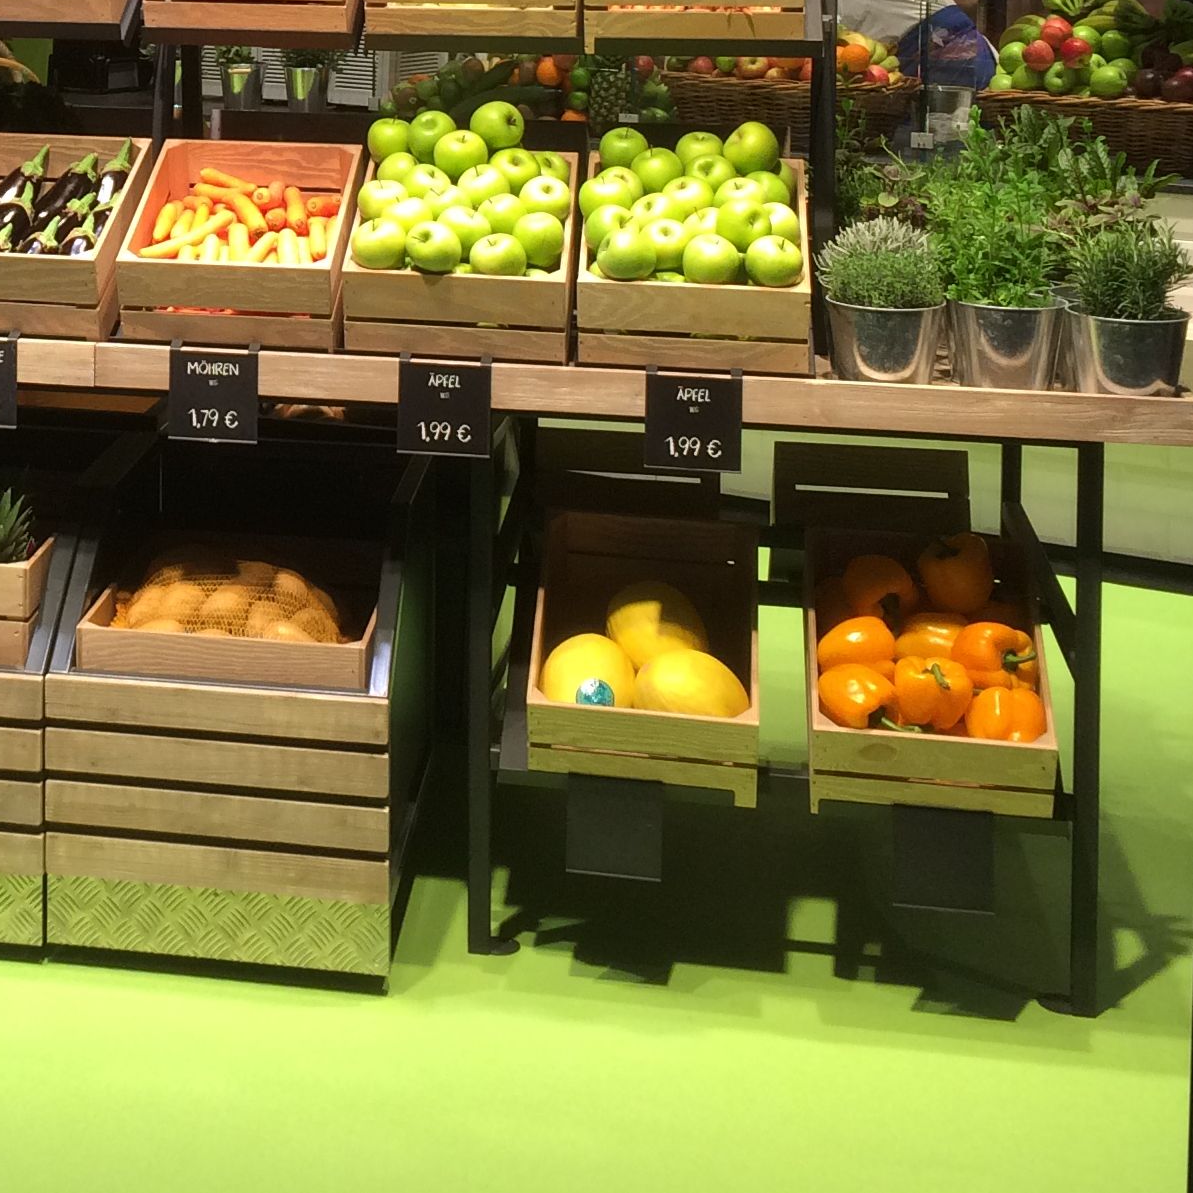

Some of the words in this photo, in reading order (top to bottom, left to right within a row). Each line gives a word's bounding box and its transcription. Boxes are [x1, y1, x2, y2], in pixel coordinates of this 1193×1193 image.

[187, 360, 240, 377] MÖHREN
[428, 372, 461, 388] ÄPFEL
[676, 385, 711, 403] ÄPFEL
[188, 408, 221, 430] 1,79
[225, 410, 240, 429] €
[416, 420, 451, 443] 1,99
[456, 423, 471, 443] €
[663, 437, 700, 462] 1,99
[706, 440, 722, 460] €
